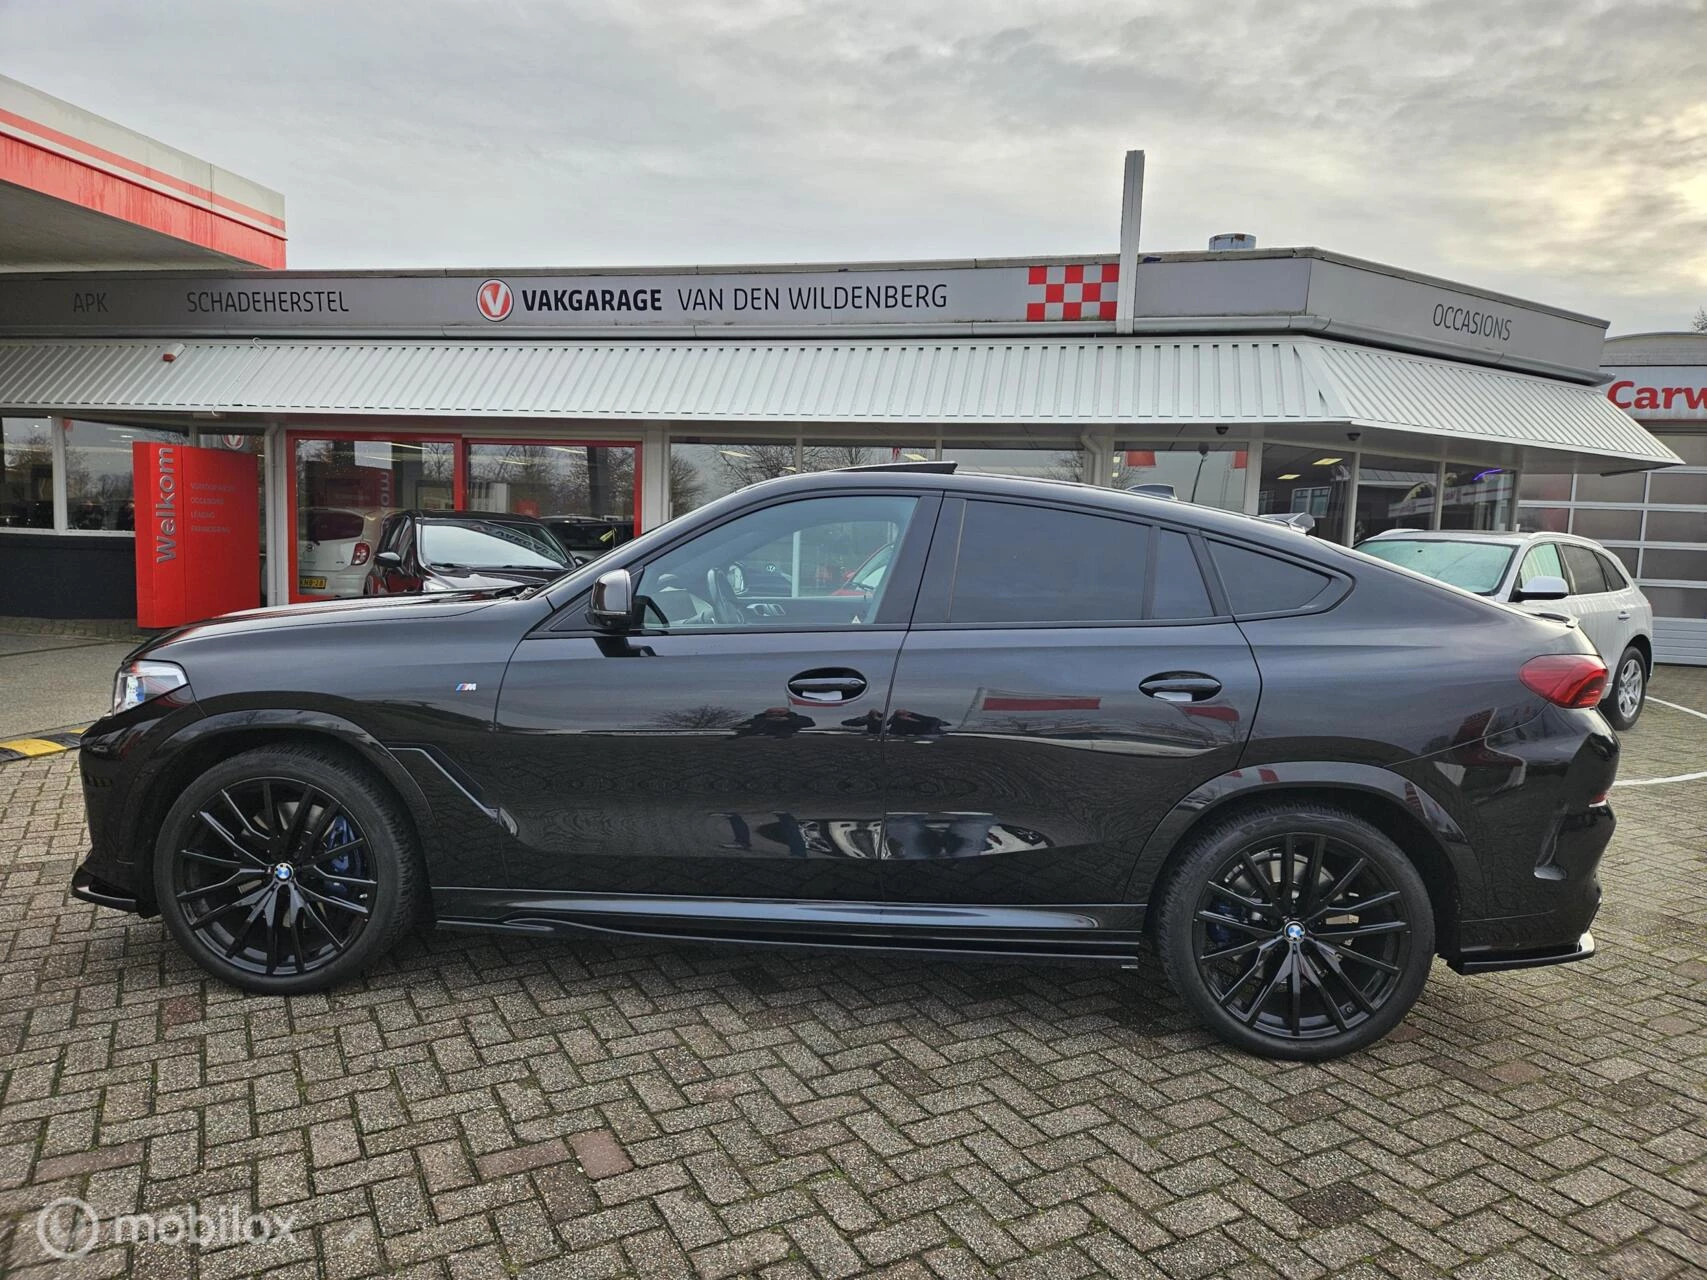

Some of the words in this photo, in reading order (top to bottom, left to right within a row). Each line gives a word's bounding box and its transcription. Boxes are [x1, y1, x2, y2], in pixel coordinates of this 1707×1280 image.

[73, 292, 109, 312] APK
[186, 291, 349, 312] SCHADEHERSTEL
[522, 288, 662, 311] VAKGARAGE
[677, 288, 723, 311] VAN
[734, 287, 779, 310] DEN
[788, 283, 947, 311] WILDENBERG
[1433, 303, 1512, 341] OCCASIONS
[156, 447, 176, 563] Welkom
